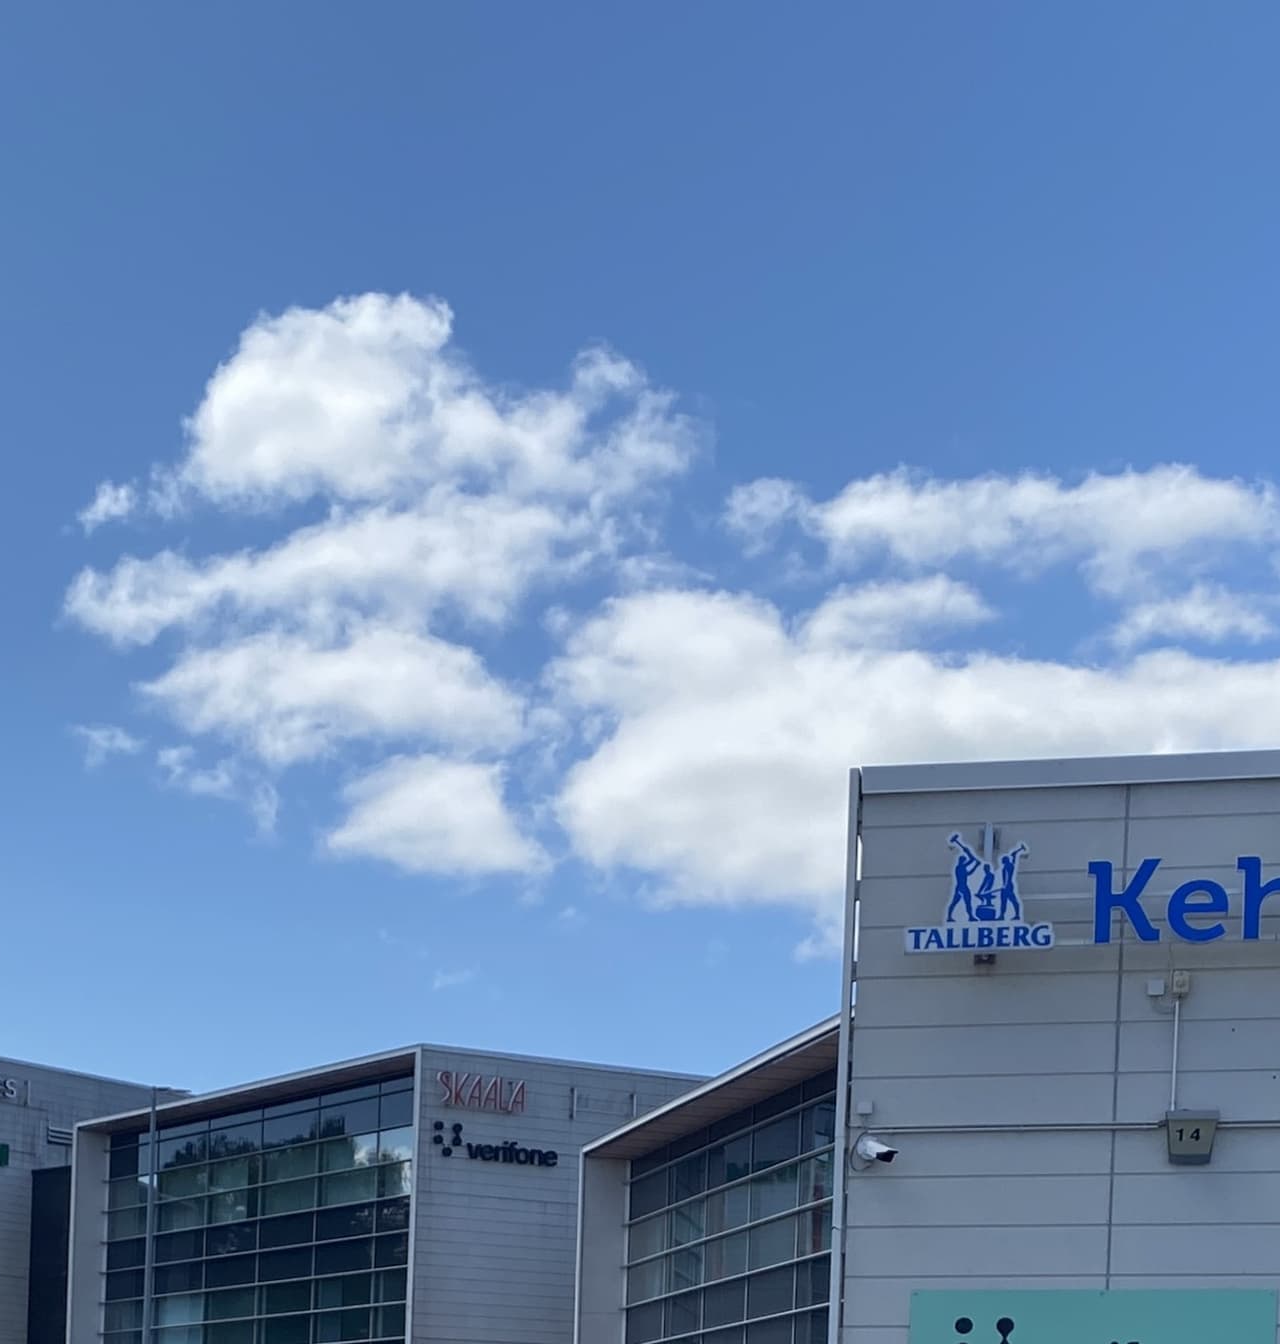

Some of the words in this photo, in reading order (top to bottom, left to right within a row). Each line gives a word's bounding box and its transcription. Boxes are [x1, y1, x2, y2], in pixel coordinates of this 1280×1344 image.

[907, 923, 1052, 950] TALLBERG
[436, 1070, 528, 1113] SKAALA
[465, 1140, 559, 1168] verifone
